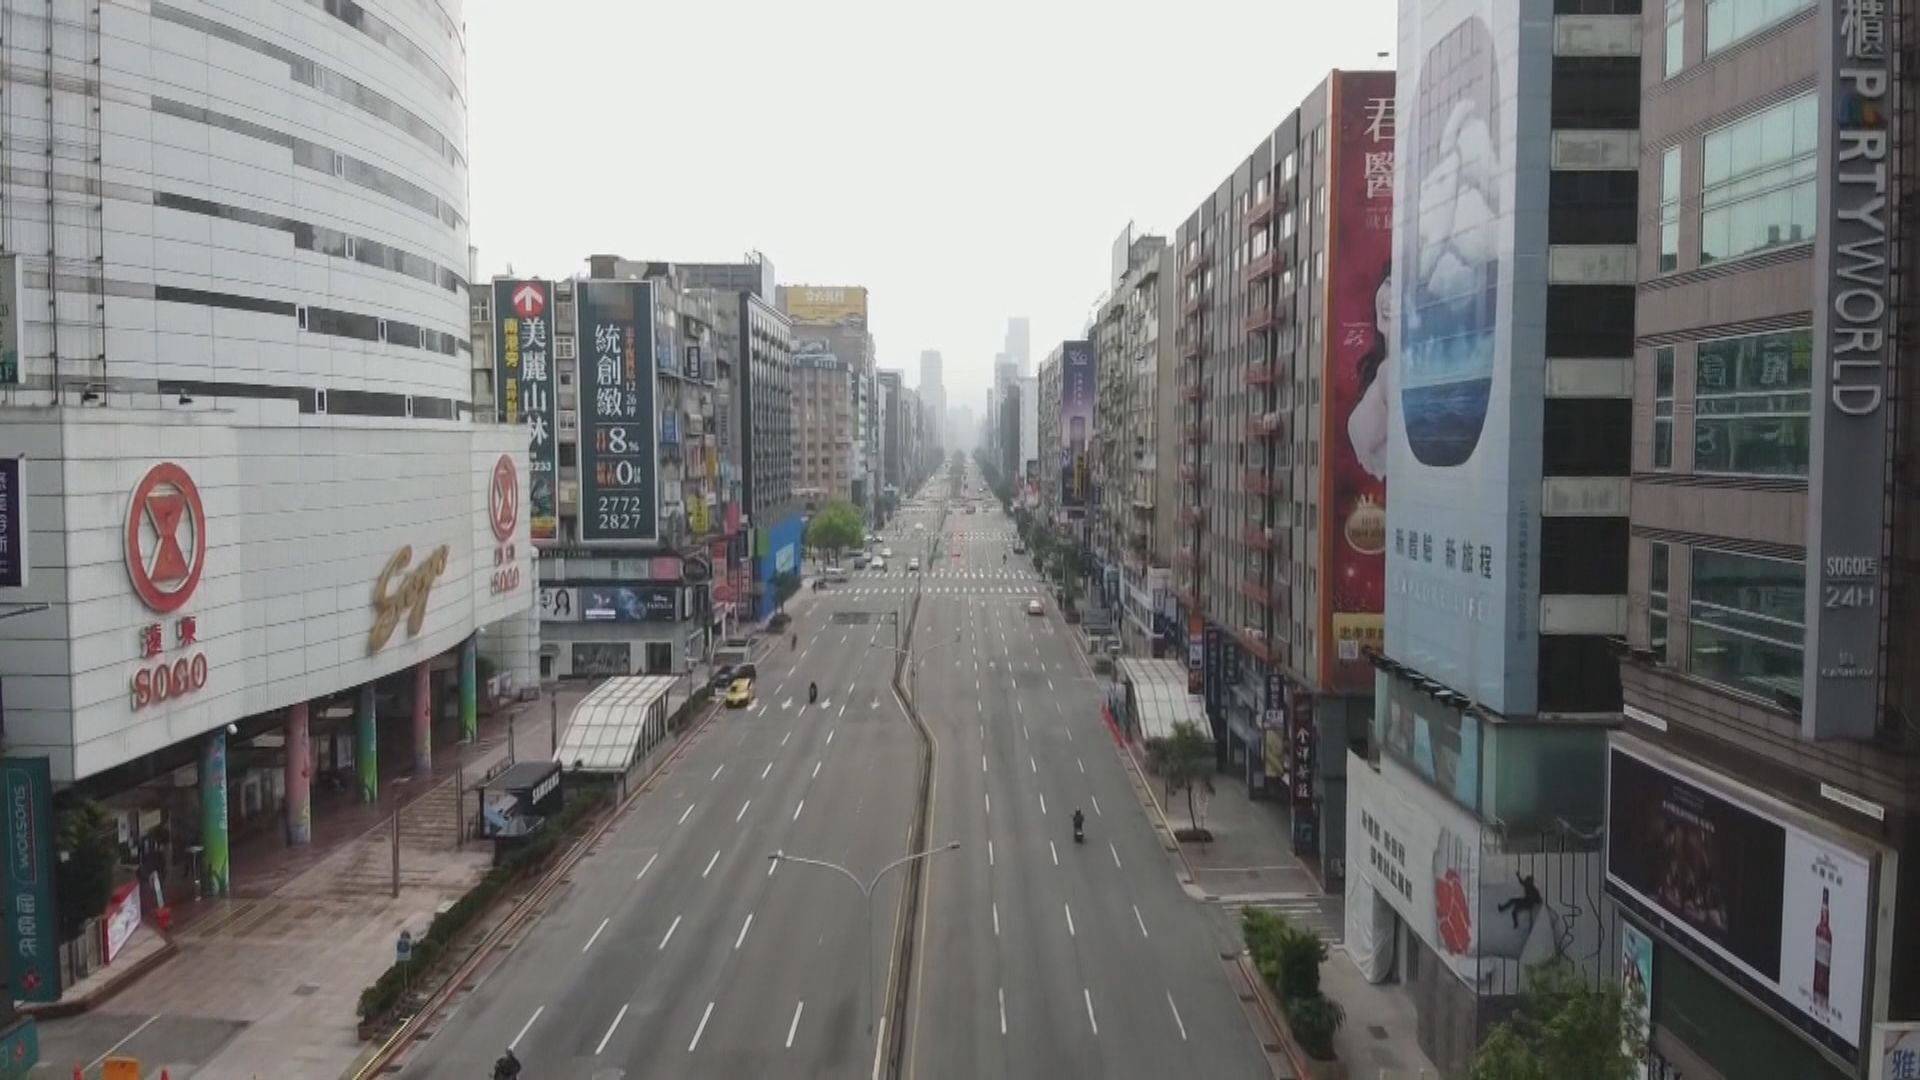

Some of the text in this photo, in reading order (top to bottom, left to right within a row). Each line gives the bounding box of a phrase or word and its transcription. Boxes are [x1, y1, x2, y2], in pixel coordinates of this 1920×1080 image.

[599, 496, 640, 512] 2772
[599, 514, 640, 529] 2827
[1825, 585, 1874, 608] 24H
[130, 652, 207, 712] SOGO
